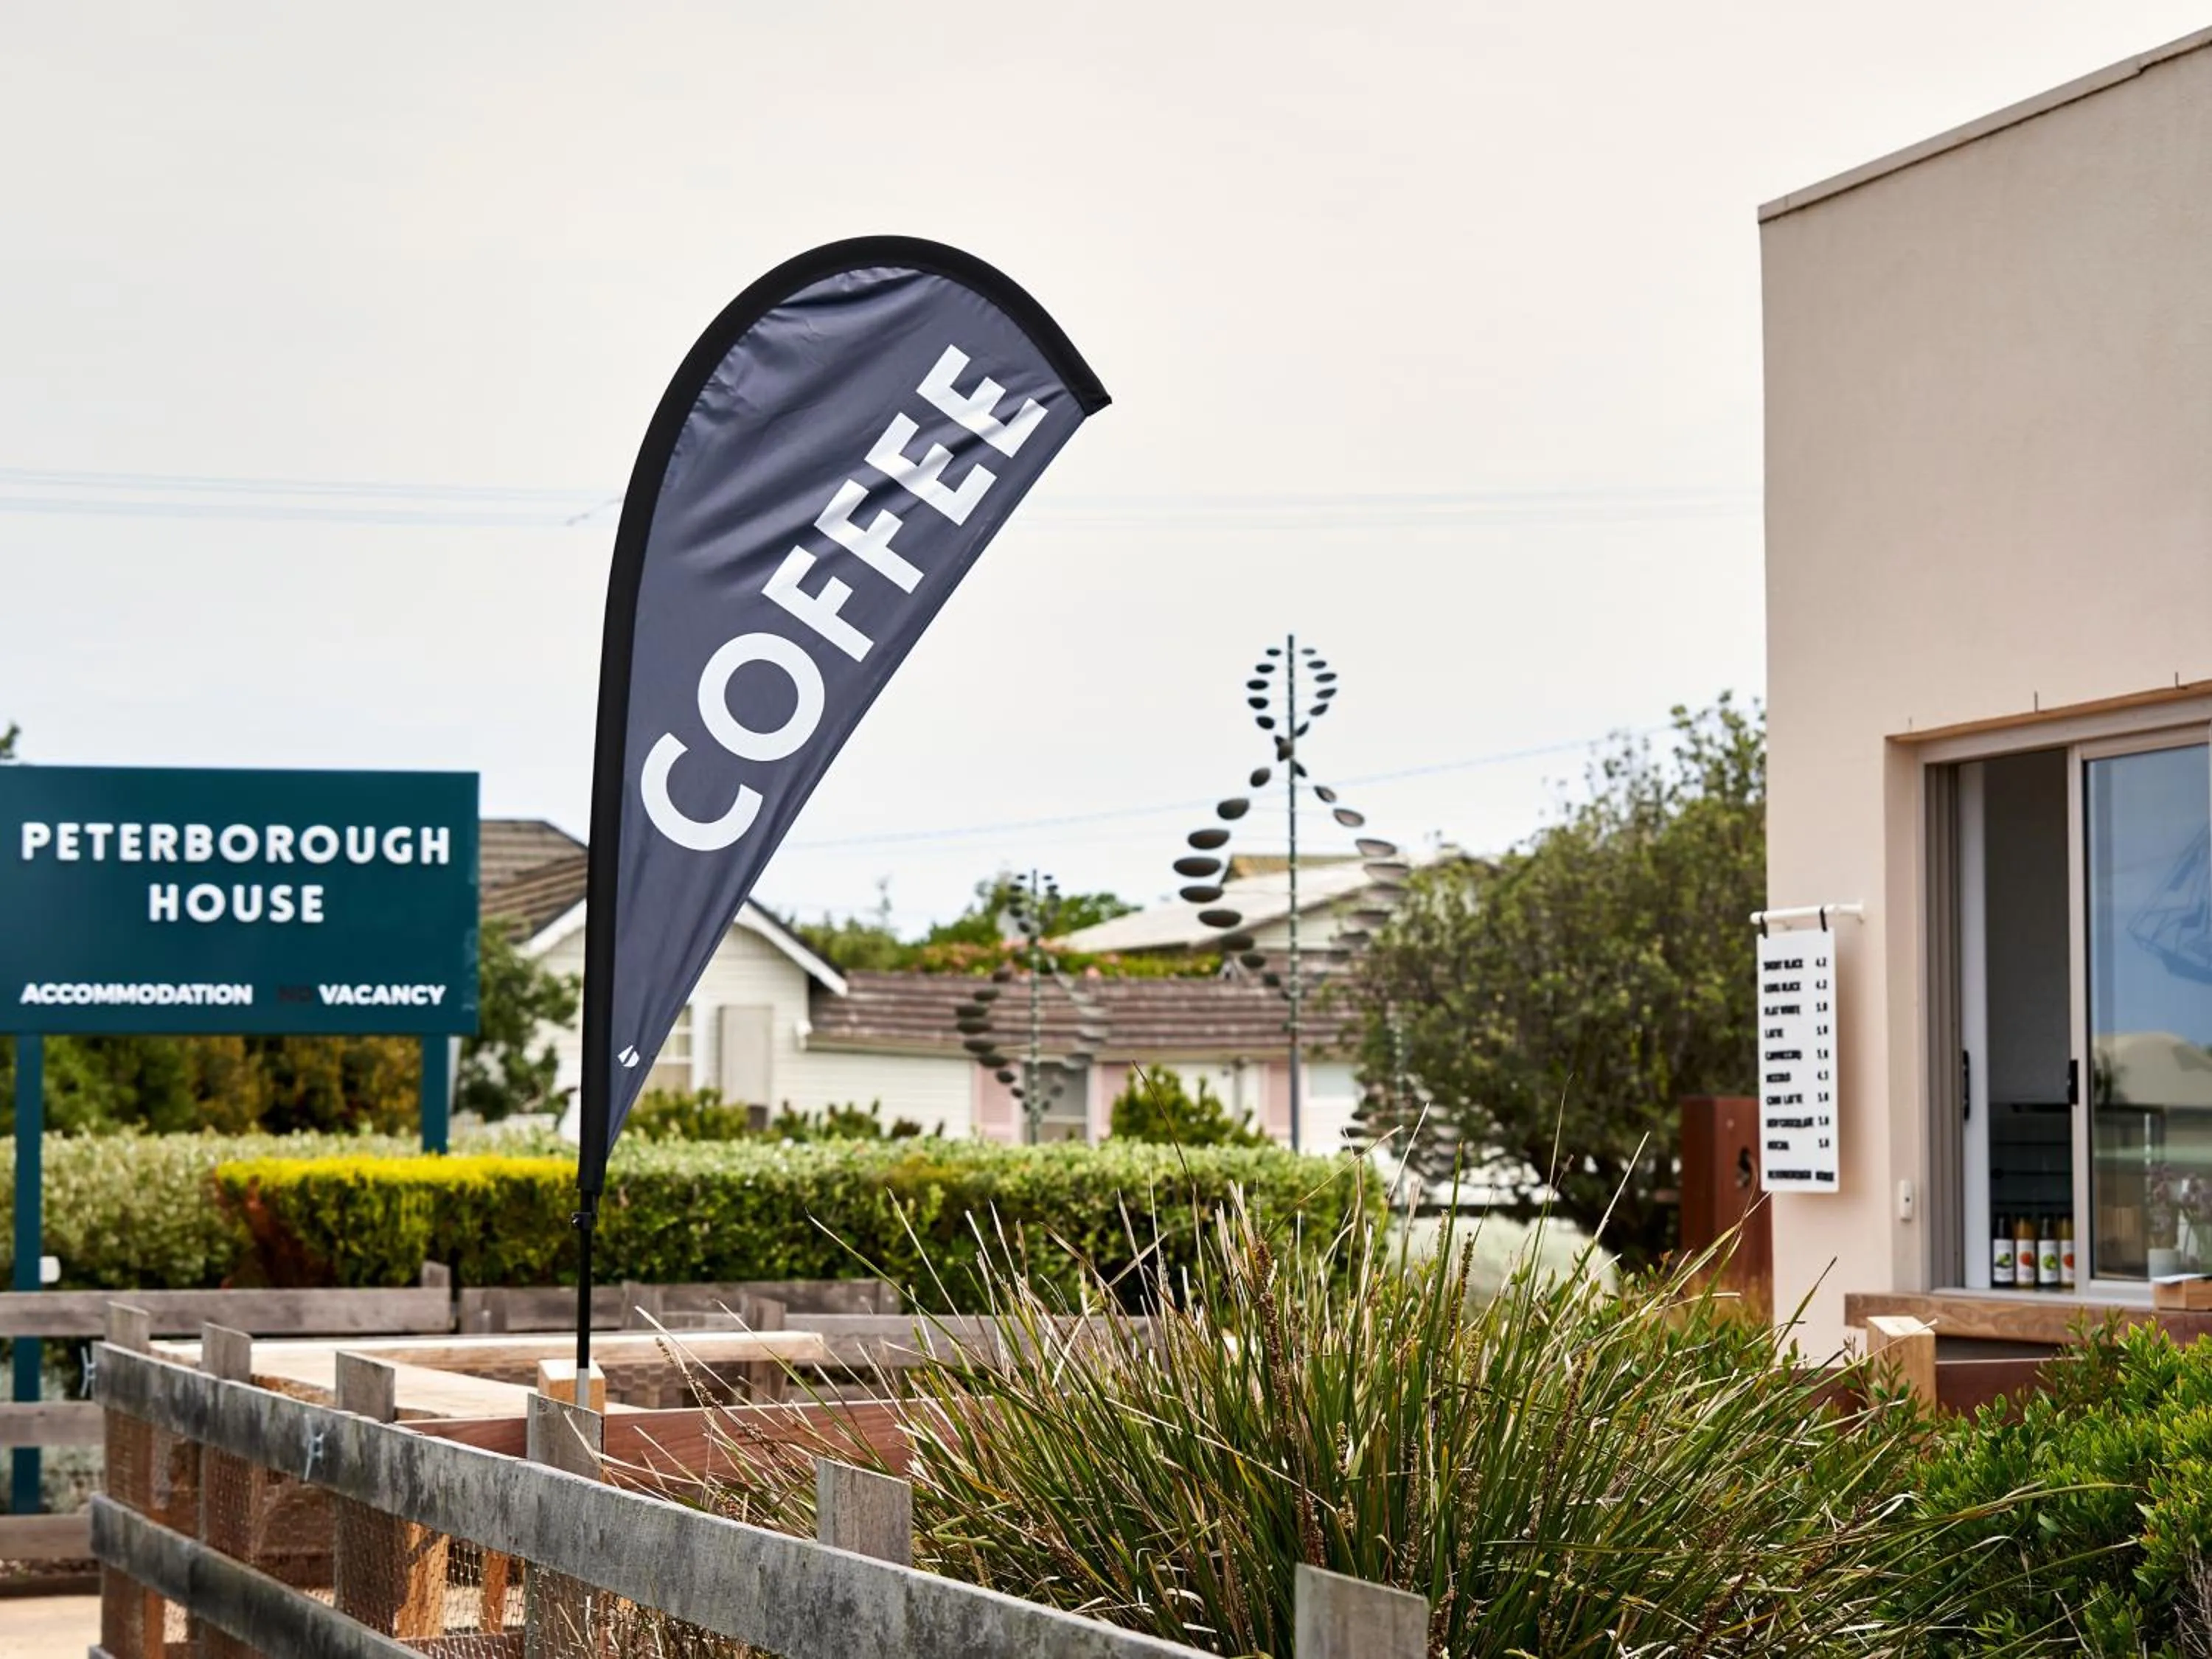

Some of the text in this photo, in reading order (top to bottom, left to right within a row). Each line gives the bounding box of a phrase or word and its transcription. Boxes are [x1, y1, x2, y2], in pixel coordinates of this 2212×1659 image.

[641, 344, 1048, 851] COFFEE
[21, 821, 450, 865] PETERBOROUGH
[149, 883, 324, 923] HOUSE
[21, 983, 253, 1005] ACCOMMODATION
[319, 984, 446, 1005] VACANCY
